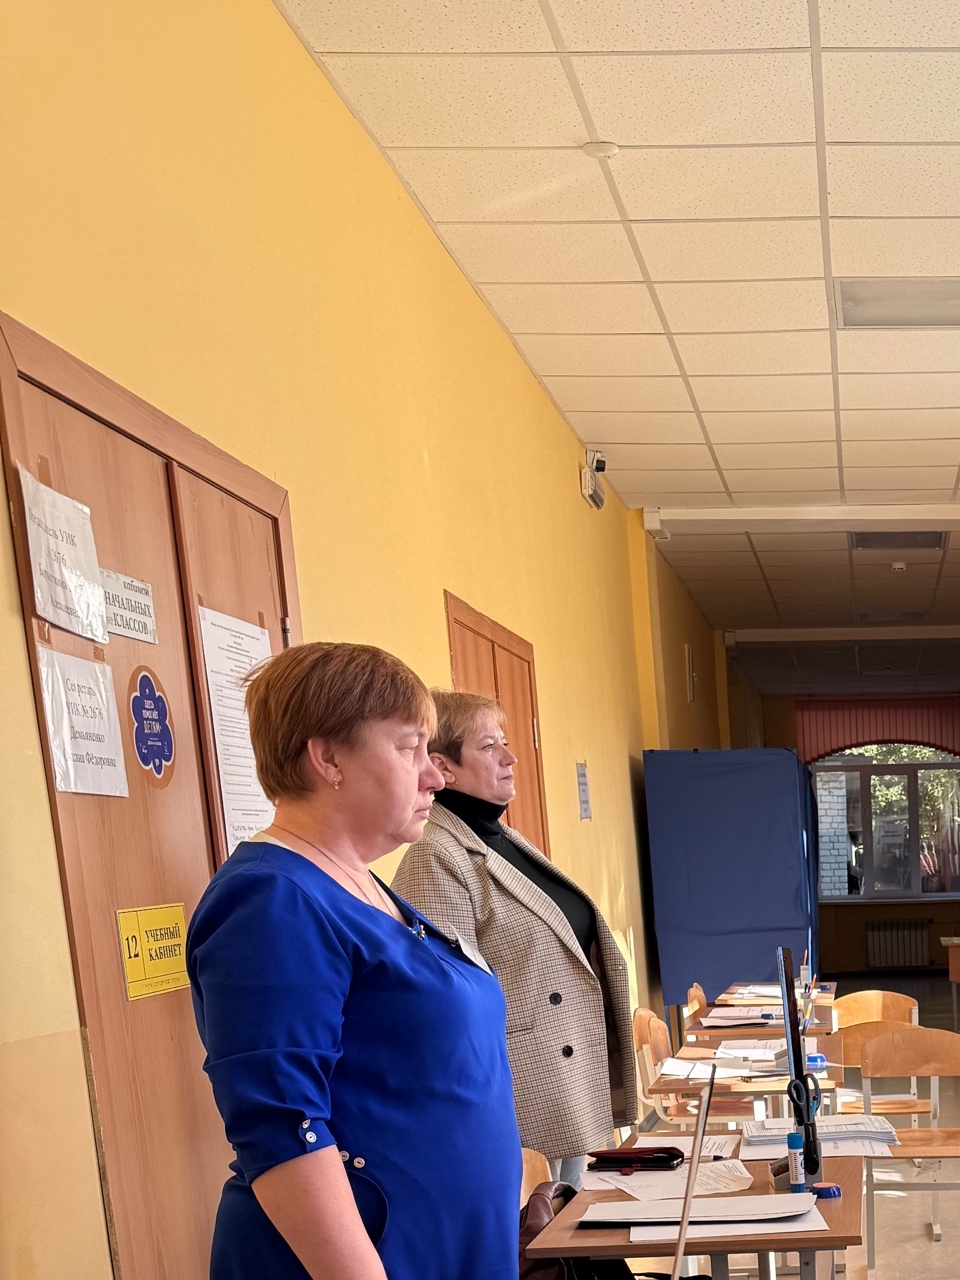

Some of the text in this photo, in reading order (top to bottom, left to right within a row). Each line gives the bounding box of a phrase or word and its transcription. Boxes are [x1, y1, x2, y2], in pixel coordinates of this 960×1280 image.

[104, 591, 152, 618] НАЧАЛЬНЫХ
[113, 613, 149, 634] КЛАССОВ
[145, 923, 181, 943] УЧЕБНЫЙ
[126, 935, 140, 959] 12
[148, 944, 182, 962] КАБИНЕТ
